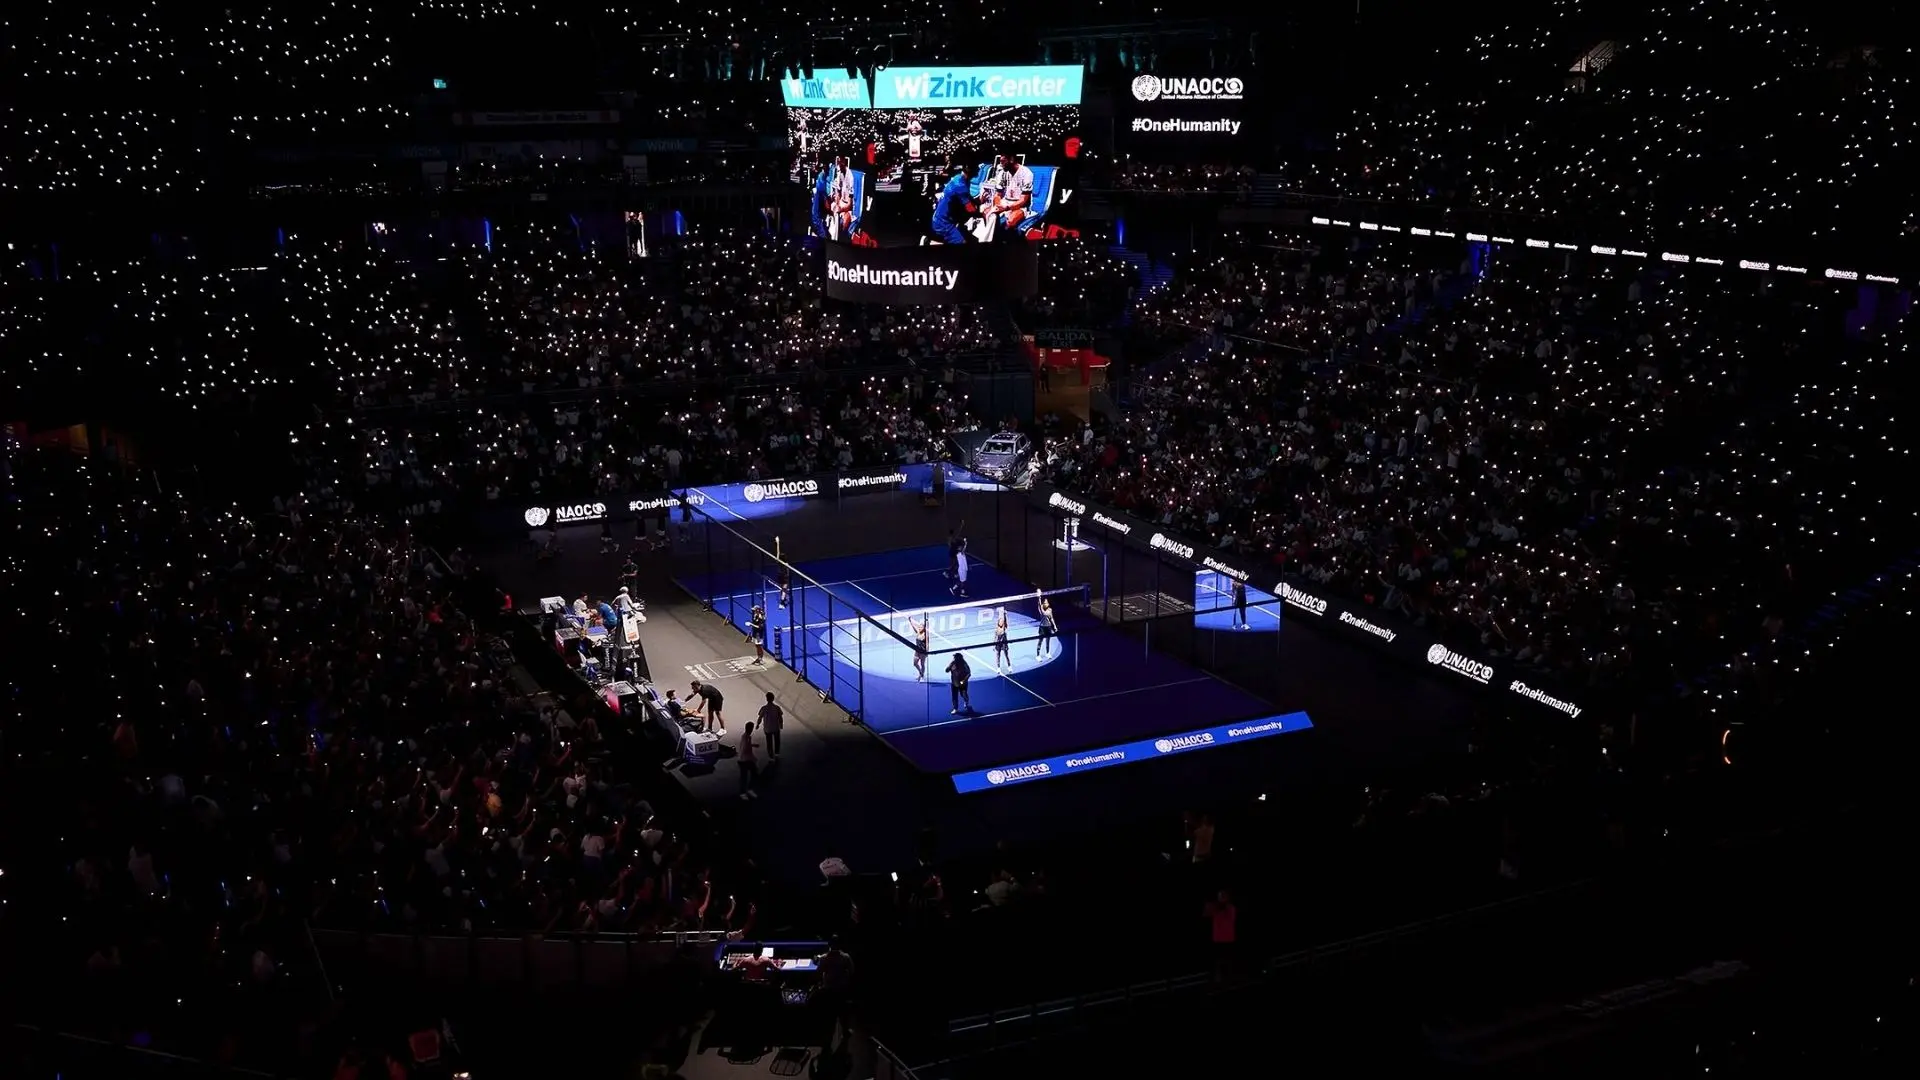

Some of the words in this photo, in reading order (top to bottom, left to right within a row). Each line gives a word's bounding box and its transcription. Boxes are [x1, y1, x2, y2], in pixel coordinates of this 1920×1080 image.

[1132, 118, 1241, 135] #OneHumanity
[828, 260, 959, 289] #OneHumanity
[838, 473, 908, 489] #OneHumanity
[628, 494, 705, 512] #OneHumnity
[1339, 611, 1397, 642] #OneHumanity
[1444, 650, 1483, 675] UNAOC
[1510, 680, 1582, 718] #OneHumanity
[1066, 751, 1125, 768] #OneHumanity
[1228, 720, 1283, 737] #OneHumanity
